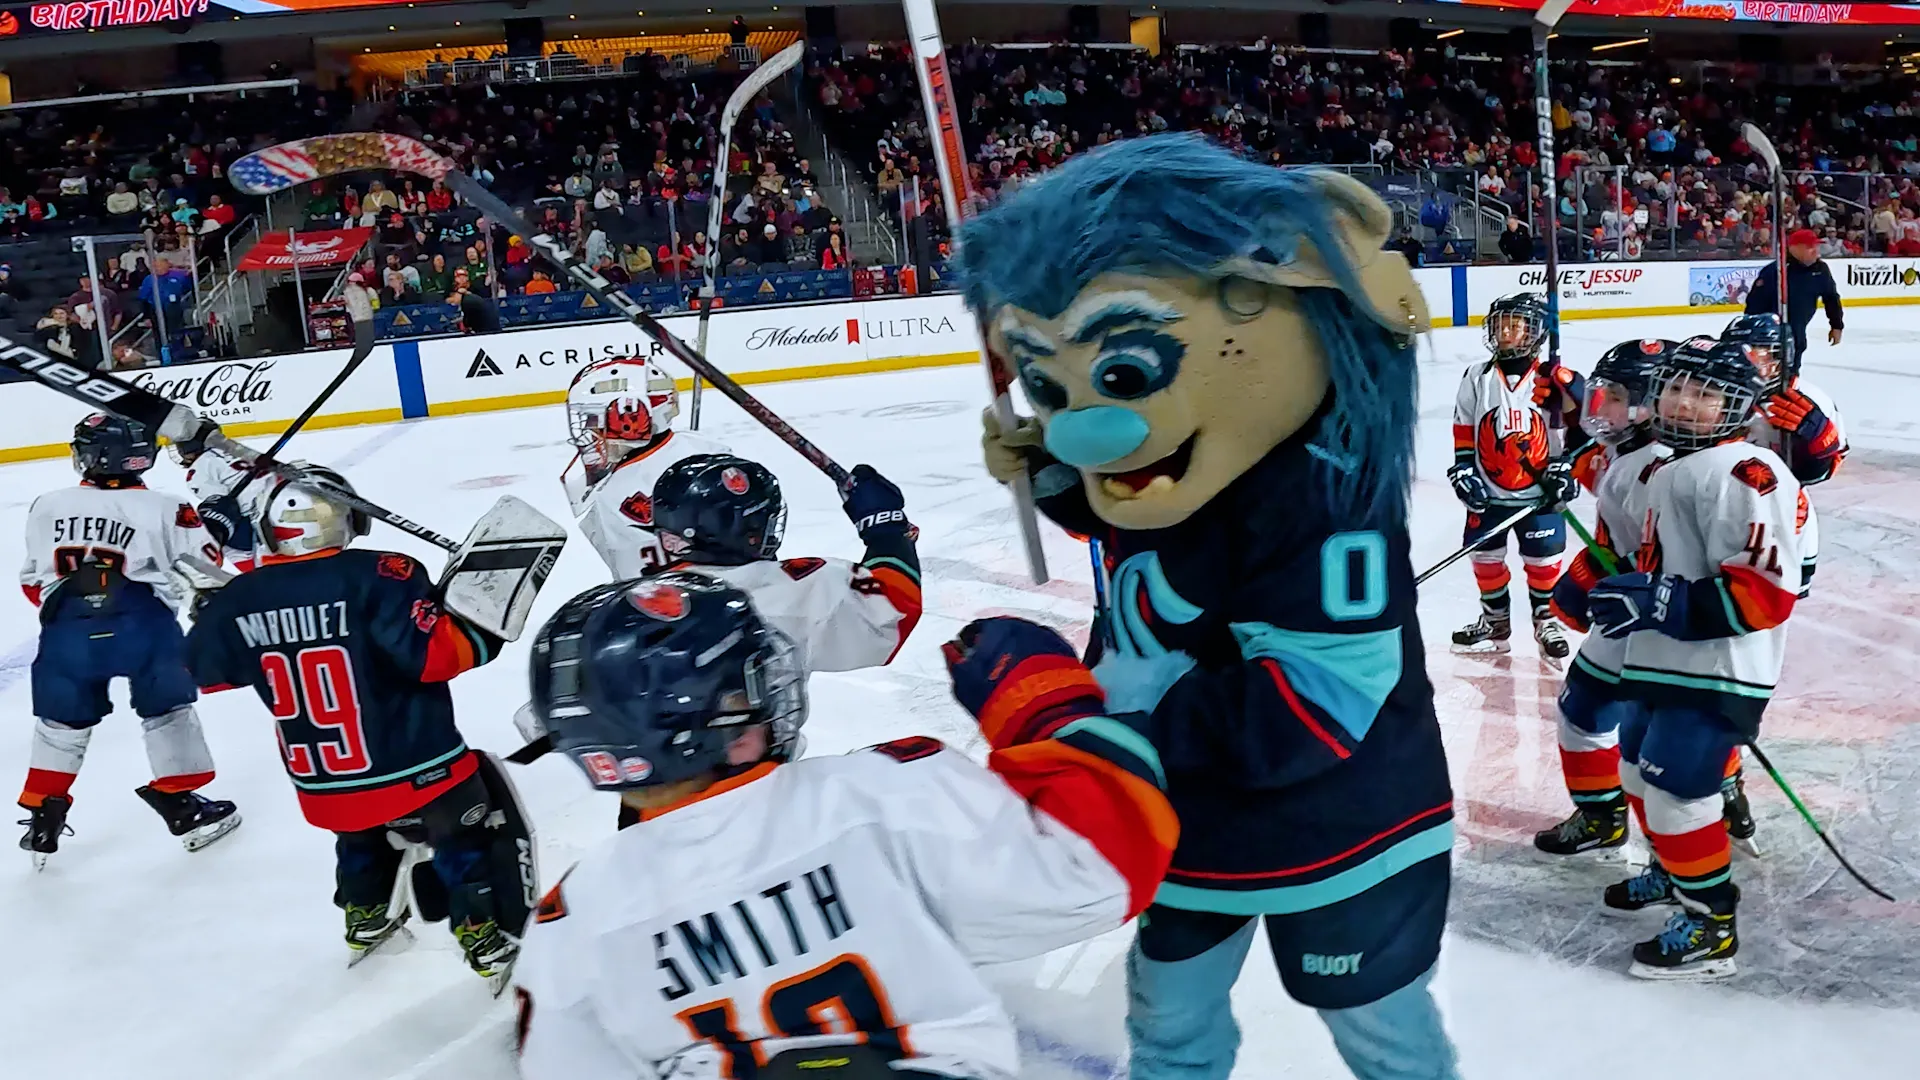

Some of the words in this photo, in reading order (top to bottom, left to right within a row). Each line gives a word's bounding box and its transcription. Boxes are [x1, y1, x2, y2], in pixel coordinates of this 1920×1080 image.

[31, 0, 208, 30] BIRTHDAY!
[1742, 1, 1852, 23] BIRTHDAY!
[1582, 269, 1643, 289] JESSUP
[745, 325, 840, 351] Michelob
[865, 315, 956, 340] ULTRA
[515, 339, 687, 369] ACRISUR
[199, 405, 252, 418] SUGAR
[1525, 528, 1556, 540] CCM
[1320, 530, 1389, 622] 0
[260, 645, 373, 777] 29
[652, 863, 855, 1001] SMITH
[1301, 951, 1364, 977] BUOY
